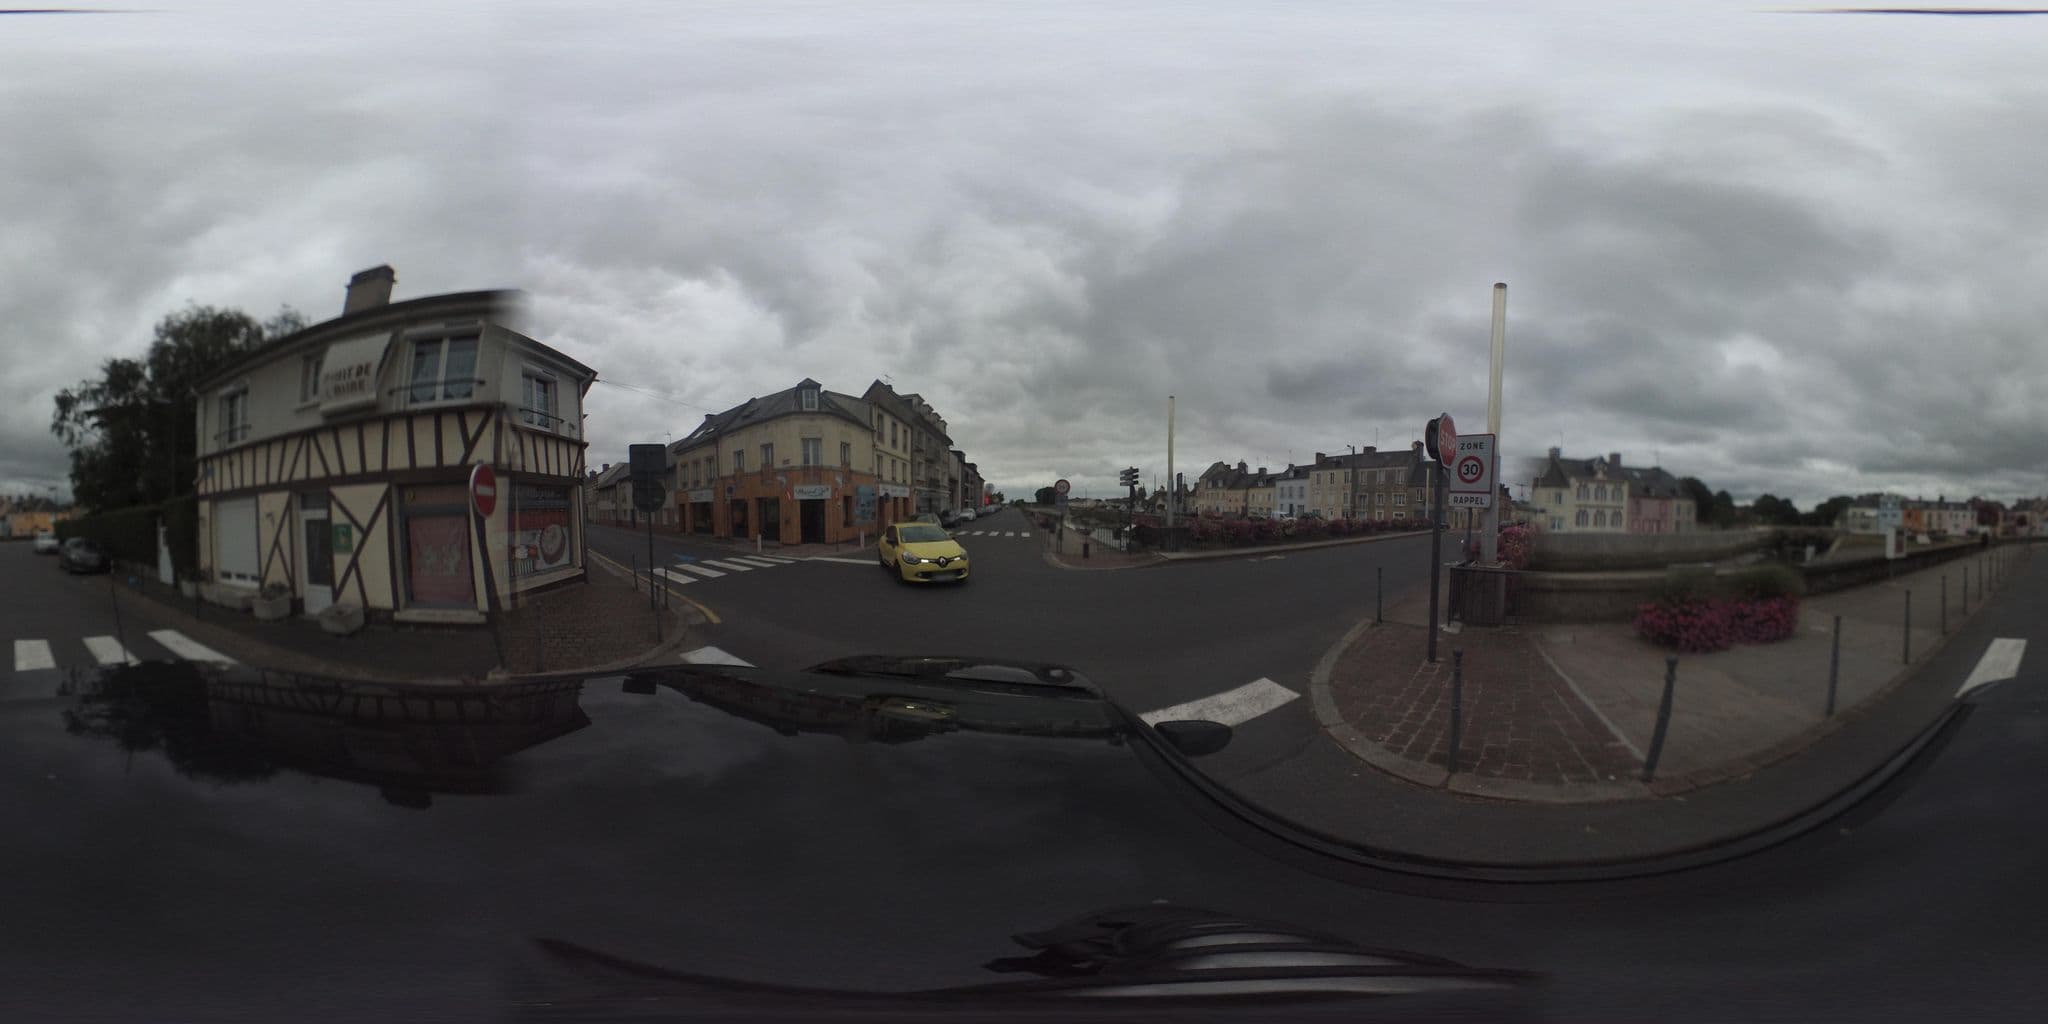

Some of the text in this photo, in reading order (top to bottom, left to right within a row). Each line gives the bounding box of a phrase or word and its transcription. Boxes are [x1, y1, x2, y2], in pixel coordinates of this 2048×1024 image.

[1440, 430, 1456, 450] STOP
[1460, 442, 1485, 451] ZONE
[1463, 464, 1478, 476] 30
[1453, 496, 1485, 505] RAPPEL
